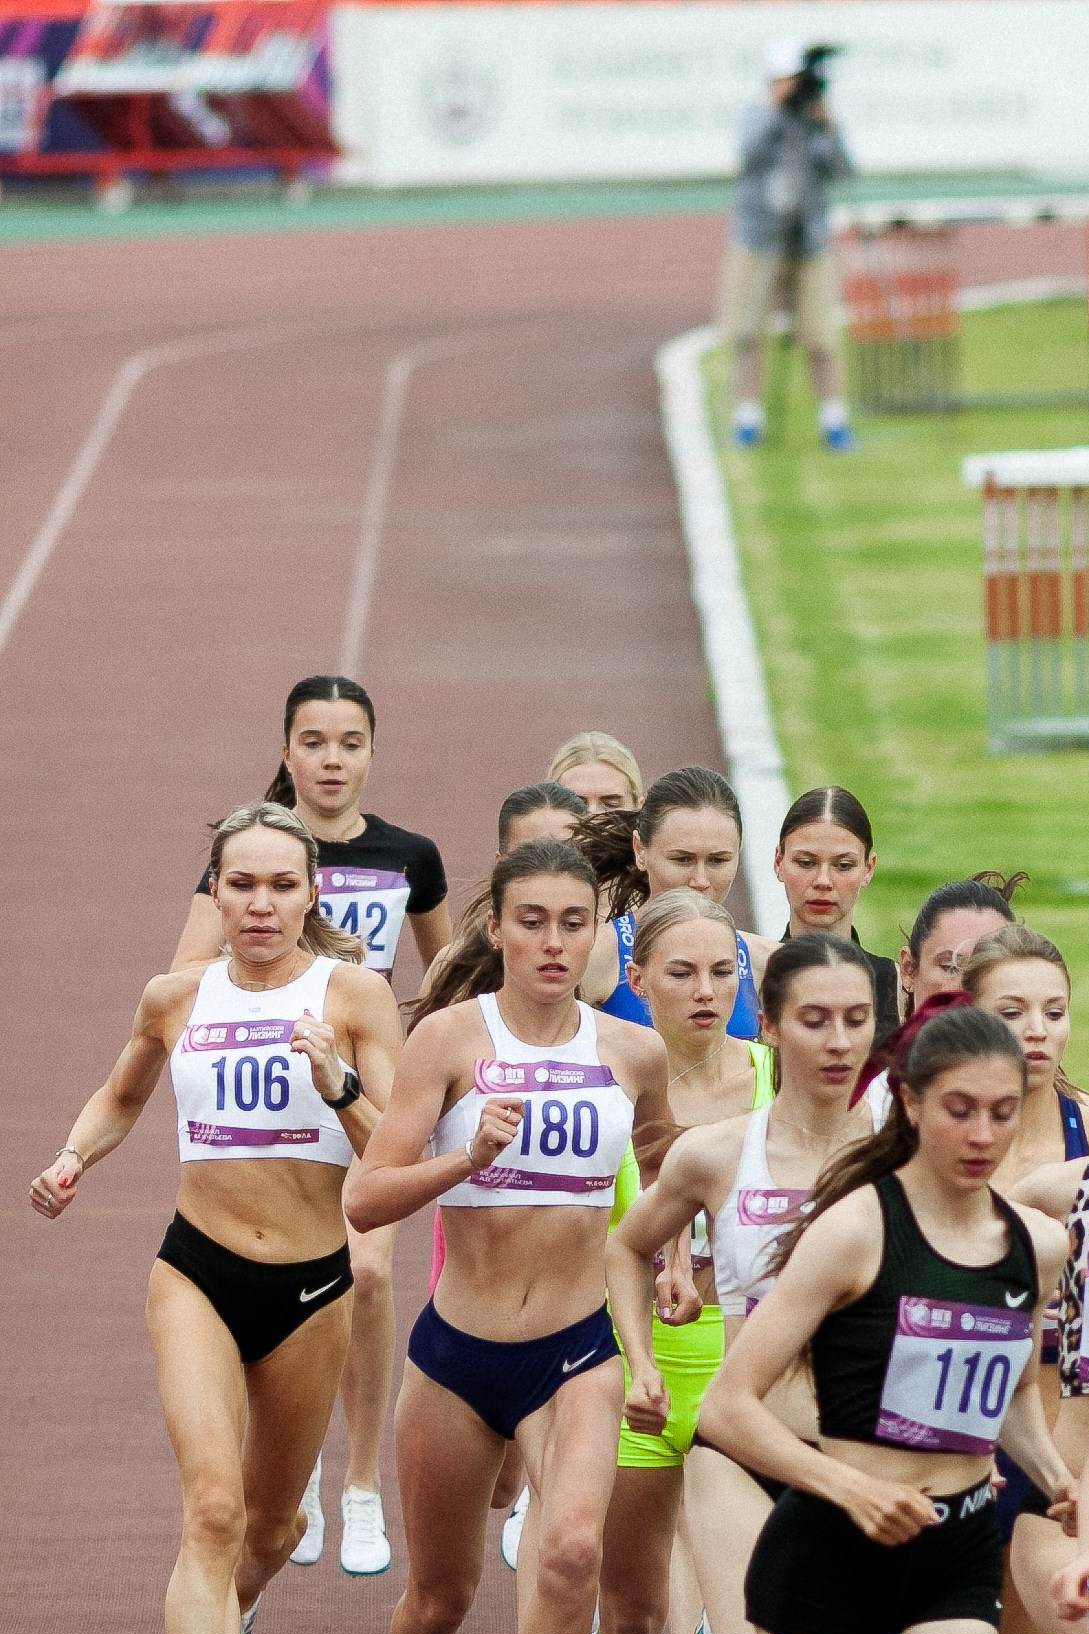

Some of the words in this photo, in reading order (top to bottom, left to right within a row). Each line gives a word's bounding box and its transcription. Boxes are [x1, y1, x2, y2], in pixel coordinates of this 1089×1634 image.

[211, 1055, 290, 1112] 106
[520, 1100, 599, 1158] 180
[932, 1347, 1011, 1419] 110
